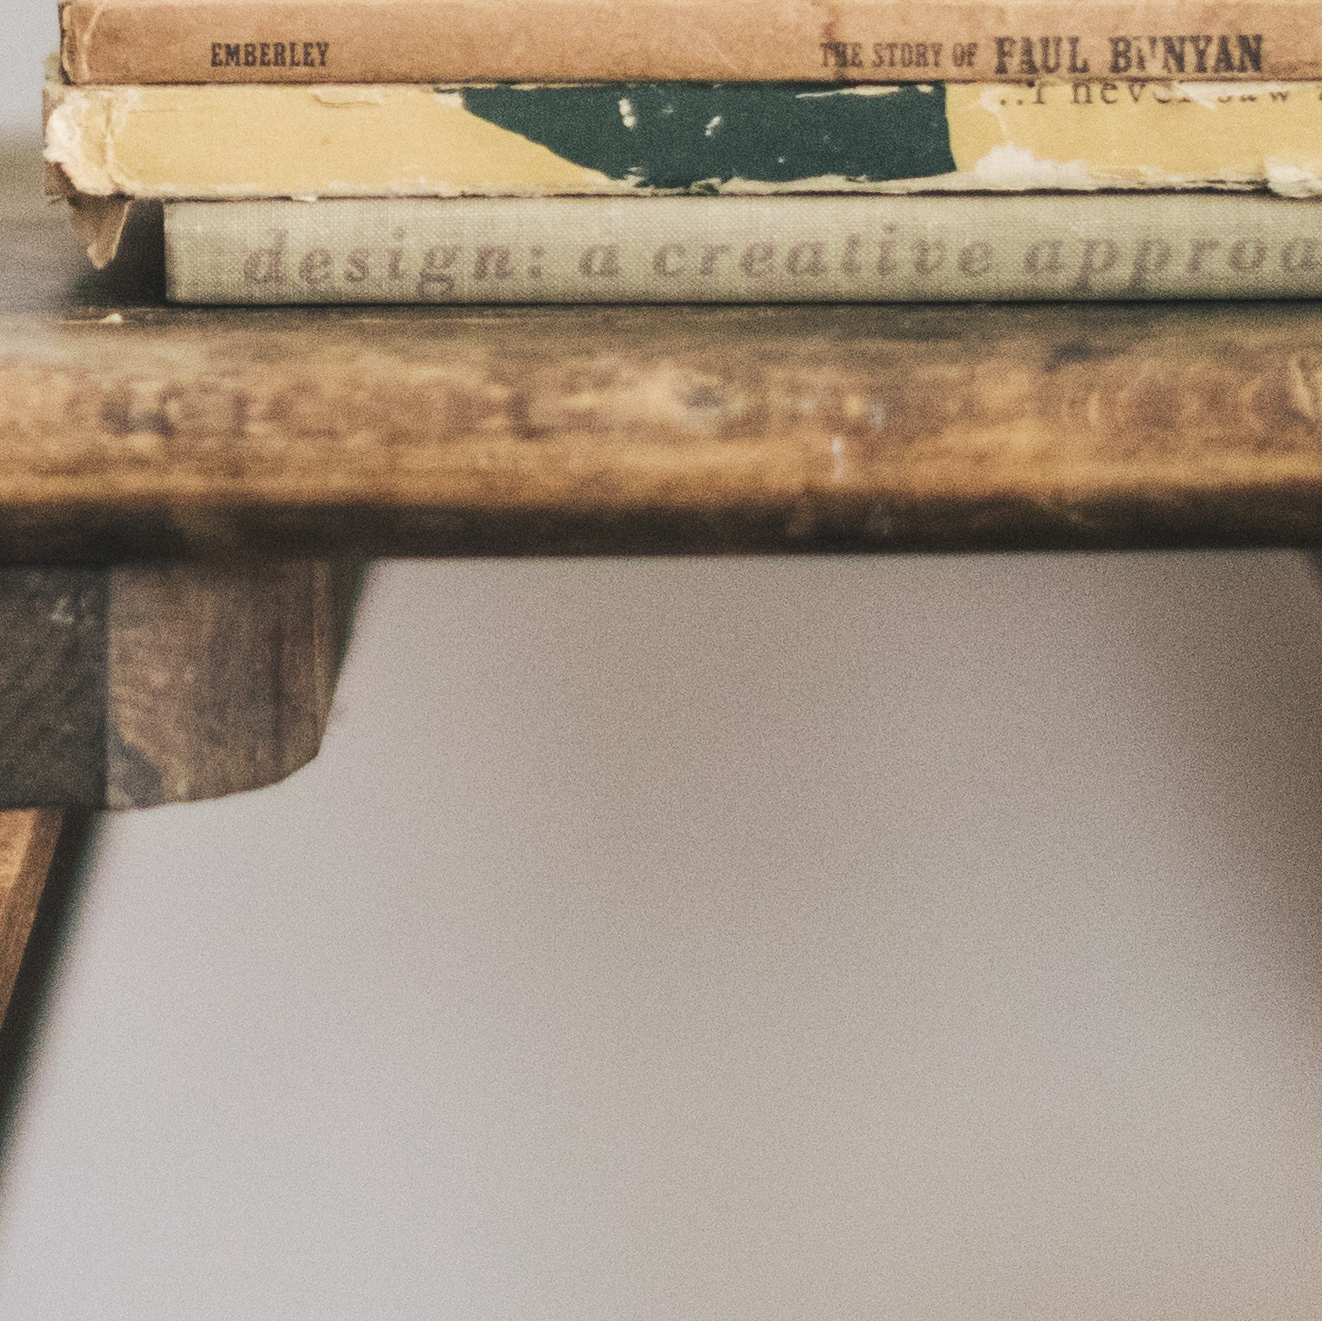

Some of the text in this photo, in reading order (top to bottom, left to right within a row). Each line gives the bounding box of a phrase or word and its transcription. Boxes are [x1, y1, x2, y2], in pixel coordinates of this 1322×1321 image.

[210, 42, 330, 67] EMBERLEY
[820, 42, 863, 68] THE
[872, 42, 943, 68] STORY
[952, 42, 978, 67] OF
[578, 243, 619, 278] a
[653, 223, 995, 278] creative
